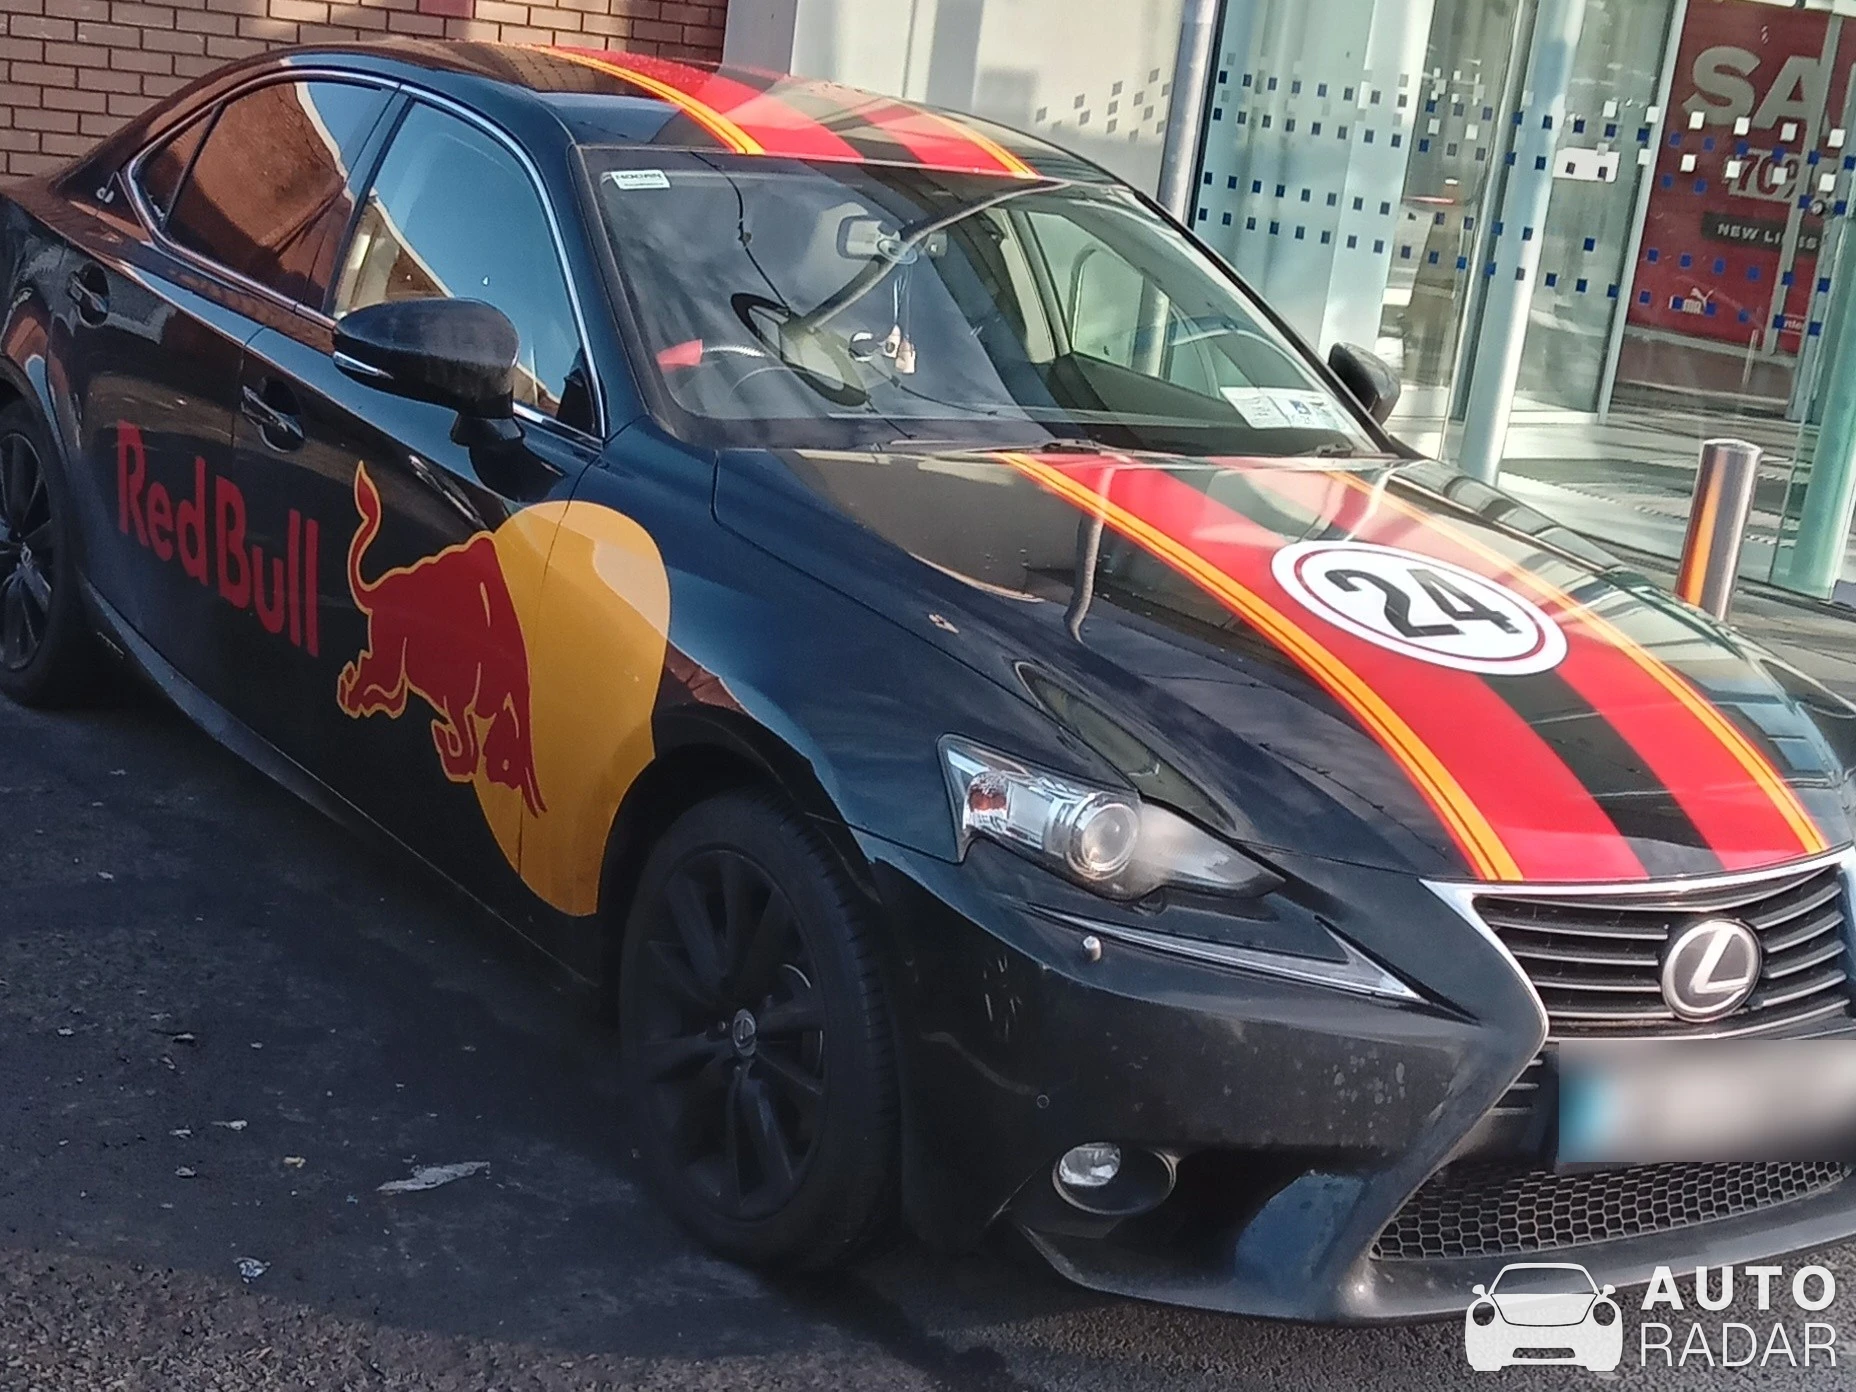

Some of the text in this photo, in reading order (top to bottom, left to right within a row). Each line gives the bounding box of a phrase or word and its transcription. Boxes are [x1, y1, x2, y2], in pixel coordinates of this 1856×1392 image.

[1717, 223, 1818, 249] NEW LIES
[1324, 568, 1523, 638] 24
